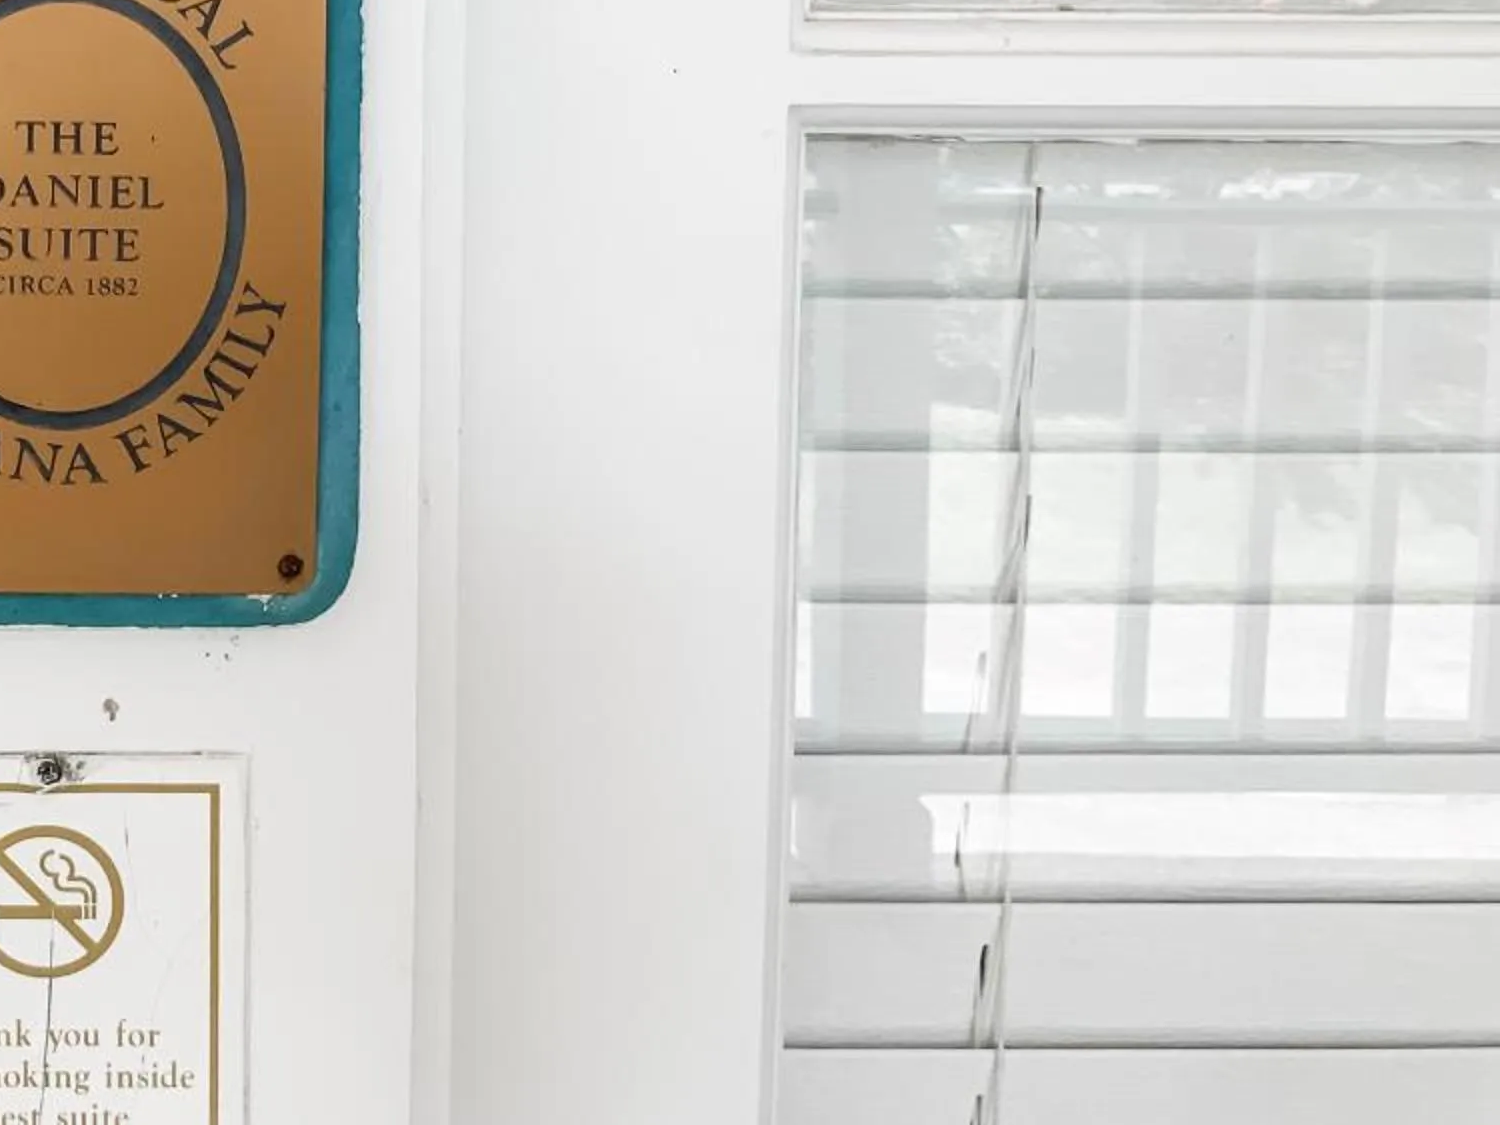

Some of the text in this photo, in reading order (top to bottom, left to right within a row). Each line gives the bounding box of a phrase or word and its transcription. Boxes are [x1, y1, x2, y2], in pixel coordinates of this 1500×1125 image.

[15, 121, 120, 156] THE
[85, 277, 139, 297] 1882
[115, 281, 287, 474] FAMILY
[47, 1027, 100, 1053] you
[117, 1018, 161, 1048] for
[106, 1059, 195, 1089] inside
